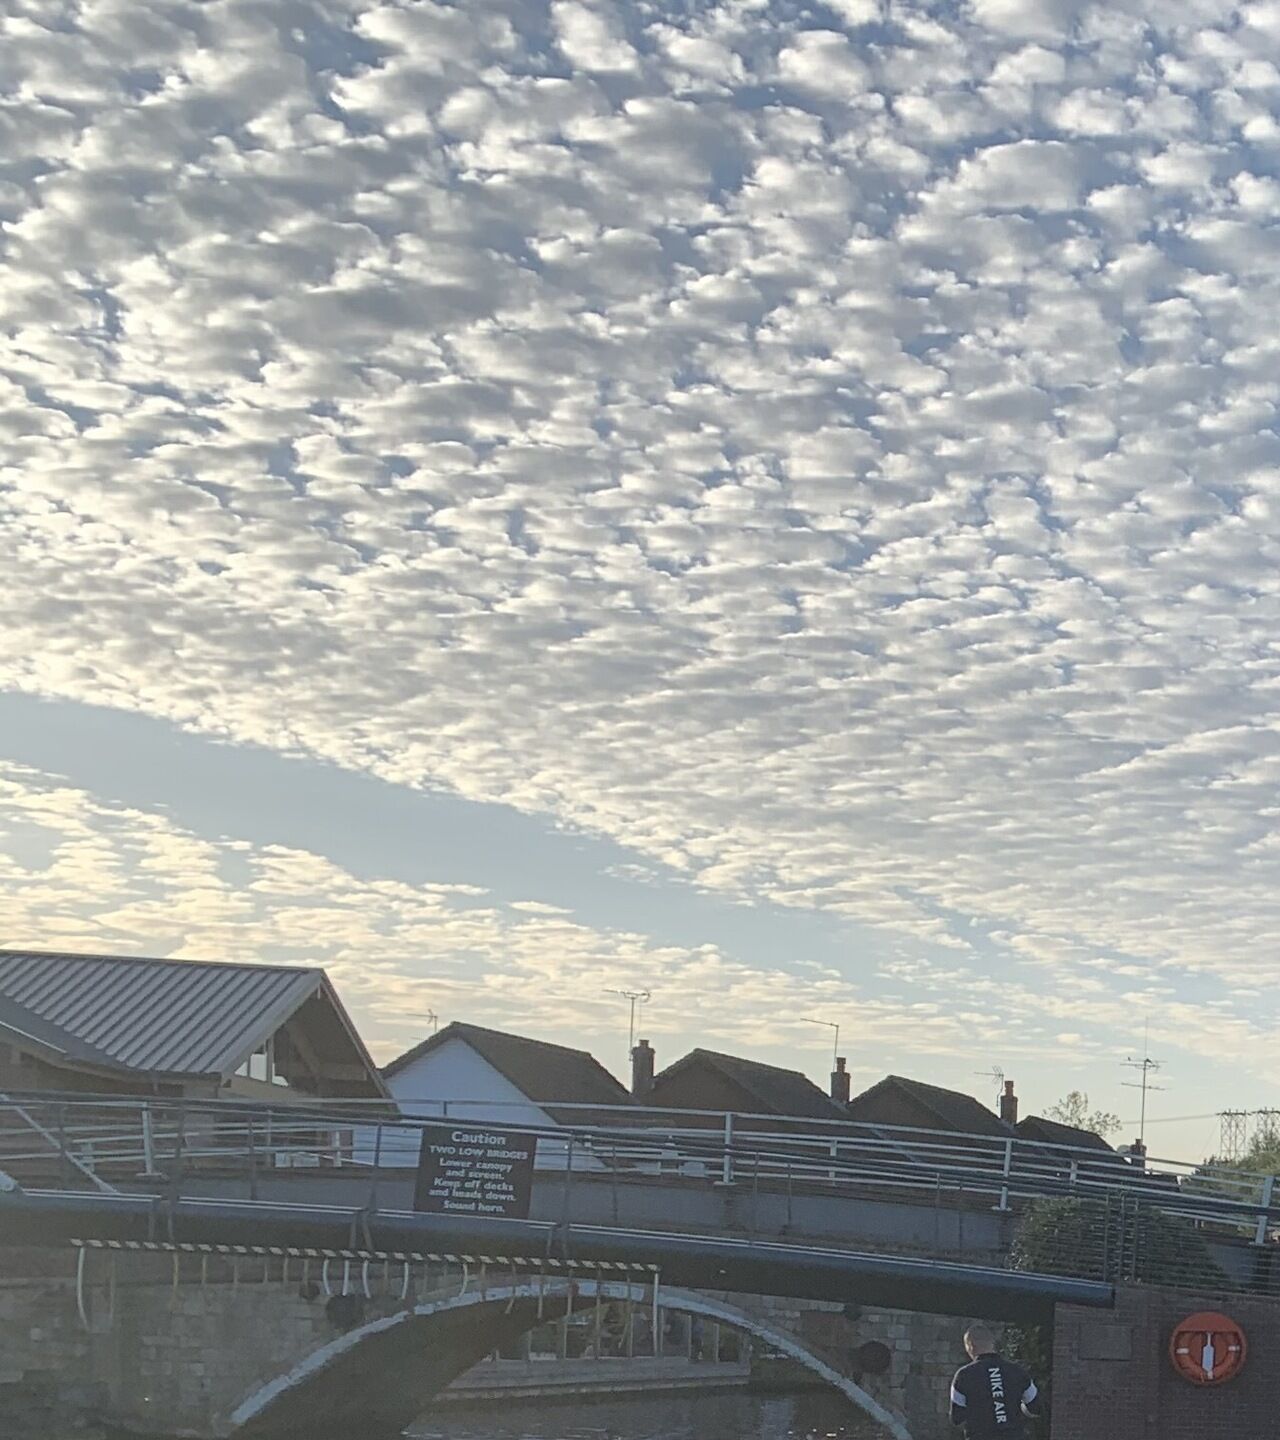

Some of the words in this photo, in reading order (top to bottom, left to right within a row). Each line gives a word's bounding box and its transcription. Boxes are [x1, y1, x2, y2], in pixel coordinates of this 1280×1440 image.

[452, 1131, 506, 1145] Caution
[430, 1145, 456, 1154] TWO
[459, 1147, 483, 1156] LOW
[487, 1149, 528, 1160] BRIDGES
[440, 1158, 472, 1167] Lower
[476, 1162, 512, 1173] canopy
[446, 1169, 465, 1177] and
[434, 1177, 460, 1188] Keep
[464, 1180, 480, 1188] off
[484, 1182, 513, 1191] decks
[429, 1188, 448, 1196] and
[452, 1189, 482, 1198] heads
[444, 1200, 475, 1210] Sound
[478, 1203, 505, 1213] horn.
[988, 1367, 1004, 1398] NIKE
[993, 1401, 1007, 1424] AIR
